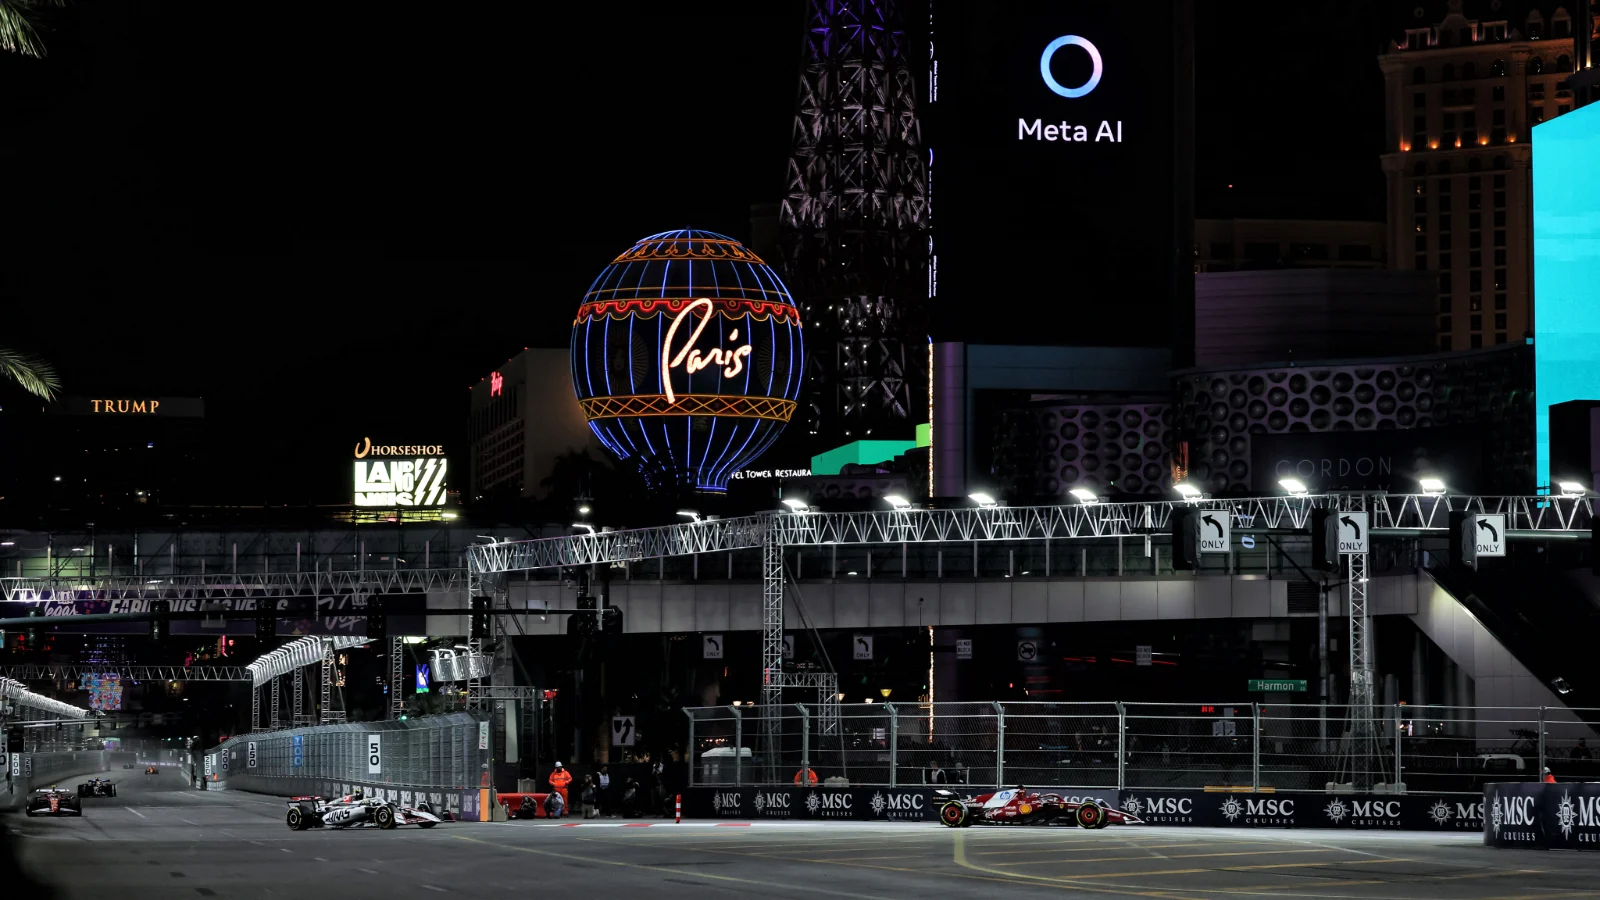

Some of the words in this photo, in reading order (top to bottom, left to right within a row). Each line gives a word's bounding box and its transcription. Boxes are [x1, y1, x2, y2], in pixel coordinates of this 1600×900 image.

[1018, 117, 1088, 142] Meta
[1094, 120, 1122, 142] AI
[661, 297, 752, 404] Paris
[90, 399, 160, 414] TRUMP
[371, 445, 443, 455] HORSESHOE
[1276, 456, 1392, 477] GORDON
[1201, 540, 1225, 549] ONLY
[1340, 542, 1363, 550] ONLY
[1476, 544, 1499, 552] ONLY
[1257, 681, 1294, 690] Harmon
[294, 736, 302, 765] 100
[370, 743, 379, 765] 50
[722, 793, 741, 808] MSC
[766, 793, 791, 808] MSC
[821, 793, 853, 809] MSC
[886, 794, 924, 809] MSC
[1145, 797, 1193, 814] MSC
[1245, 799, 1295, 816] MSC
[1351, 800, 1401, 818] MSC
[1456, 802, 1484, 819] MS
[1503, 796, 1535, 826] MSC
[1503, 831, 1536, 841] CRUISES
[1578, 832, 1600, 843] CRU
